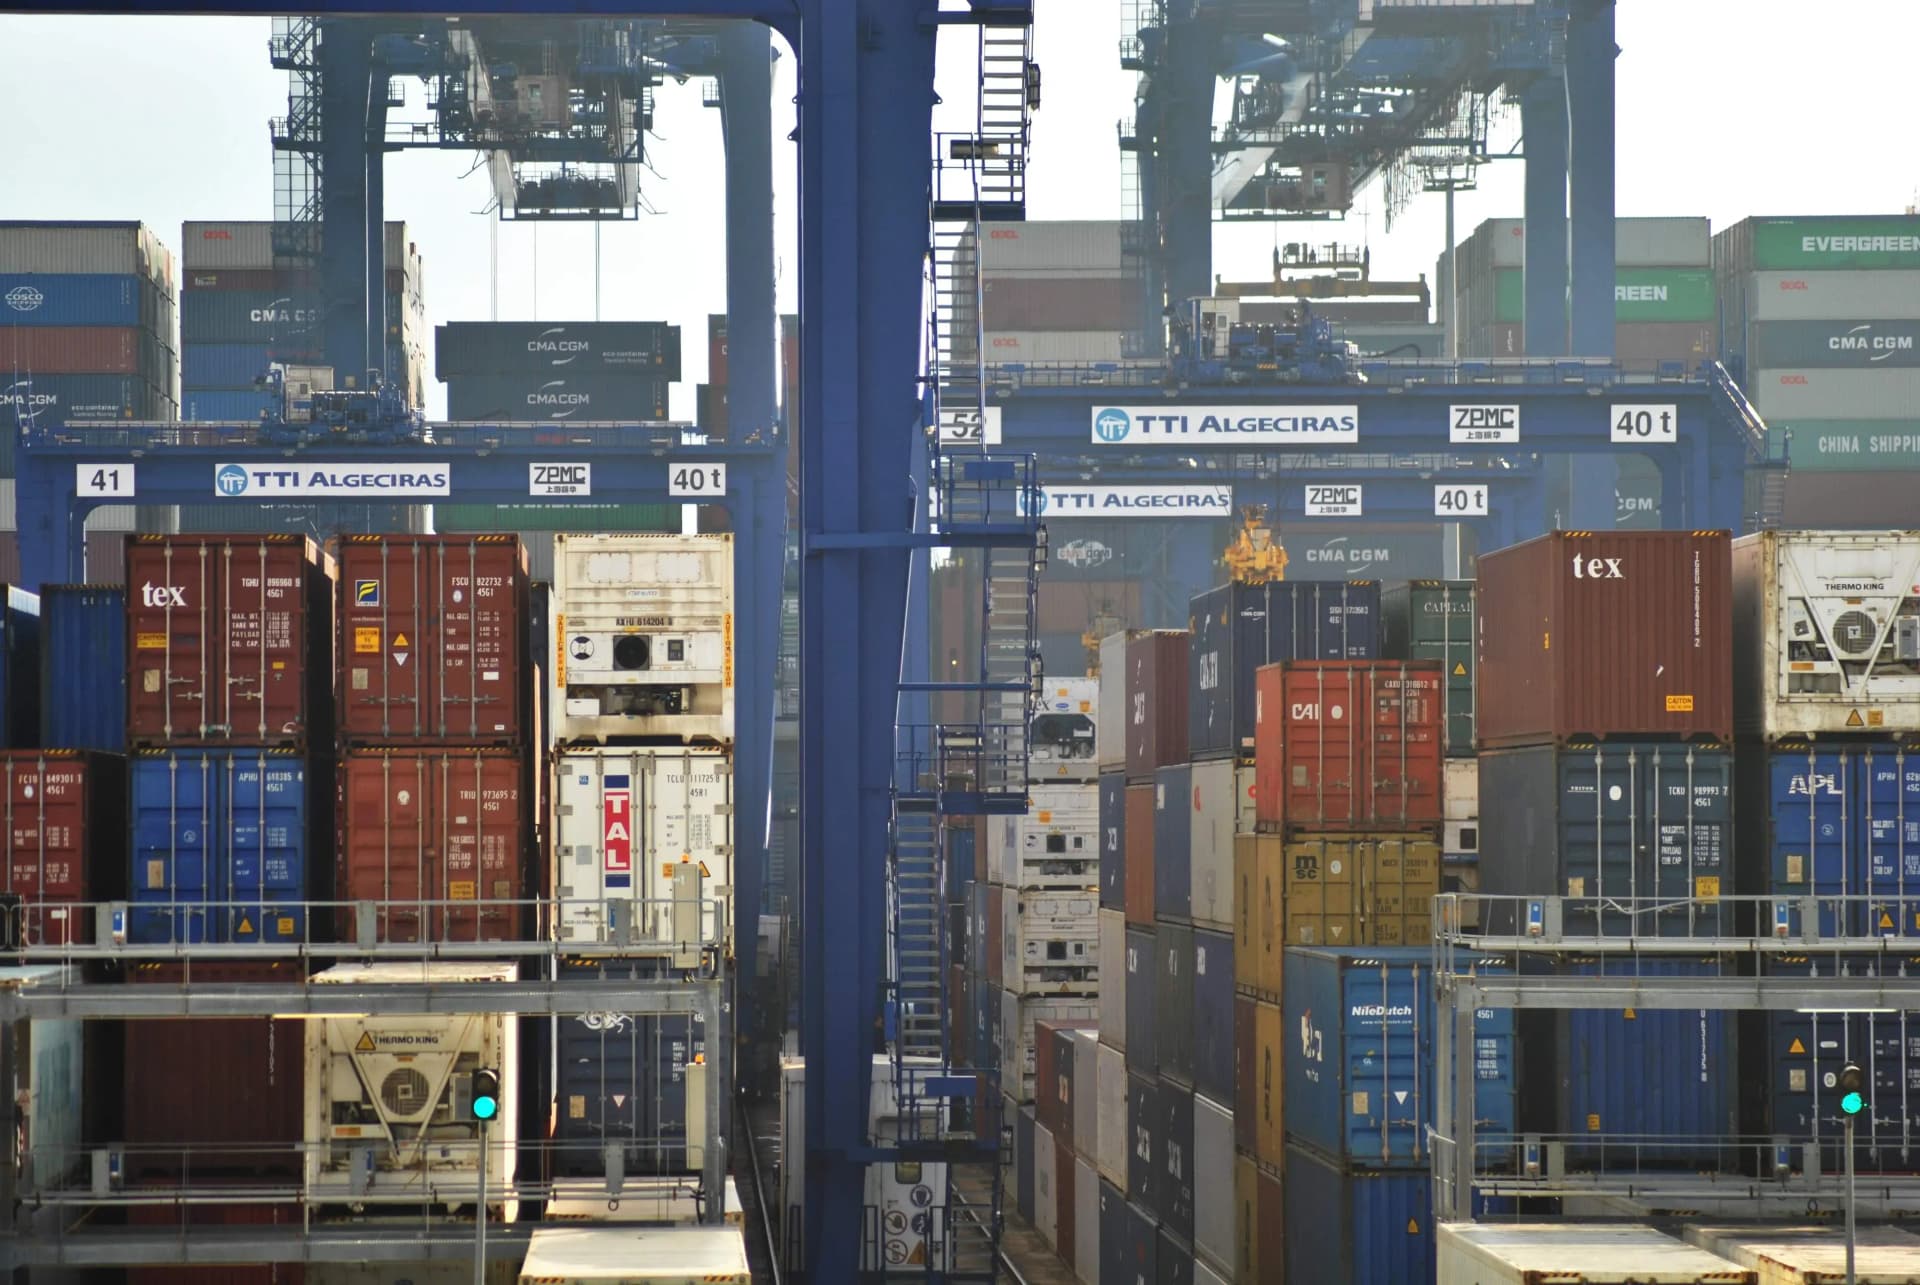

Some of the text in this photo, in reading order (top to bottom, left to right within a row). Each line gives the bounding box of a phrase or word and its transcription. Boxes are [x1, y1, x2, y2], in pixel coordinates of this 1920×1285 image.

[1803, 236, 1920, 252] EVERGREE
[5, 293, 43, 301] COSCO
[527, 341, 589, 351] CMA CGM
[1829, 337, 1913, 349] CMA CGM
[527, 394, 589, 404] CMA CGM
[1136, 415, 1355, 433] TTI ALGECIRAS
[1454, 408, 1514, 428] ZPMC
[1616, 411, 1671, 436] 40 t
[1819, 436, 1920, 452] CHINA SHIPPI
[91, 469, 120, 491] 41
[253, 470, 447, 488] TTI ALGECIRAS
[534, 466, 586, 484] ZPMC
[673, 468, 721, 490] 40 t
[1052, 493, 1229, 508] TTI ALGECIRAS
[1309, 487, 1357, 504] ZPMC
[1439, 490, 1483, 510] 40 t
[1306, 549, 1389, 562] CMA CGM
[1573, 552, 1623, 578] tex
[452, 577, 469, 586] FSCU
[142, 581, 187, 607] tex
[477, 588, 494, 597] 45G1
[1292, 704, 1319, 720] CAI
[667, 775, 684, 783] TCLU
[1788, 774, 1842, 795] APL
[46, 786, 64, 795] 45G1
[460, 791, 476, 799] TRIU
[690, 788, 707, 797] 45R1
[1669, 787, 1685, 795] TCKU
[483, 802, 499, 811] 45G1
[1694, 798, 1711, 806] 45G1
[605, 795, 629, 868] TAL
[1352, 1005, 1412, 1016] NileDutch
[1477, 1010, 1494, 1019] 45G1
[374, 1035, 439, 1044] THERMO KING
